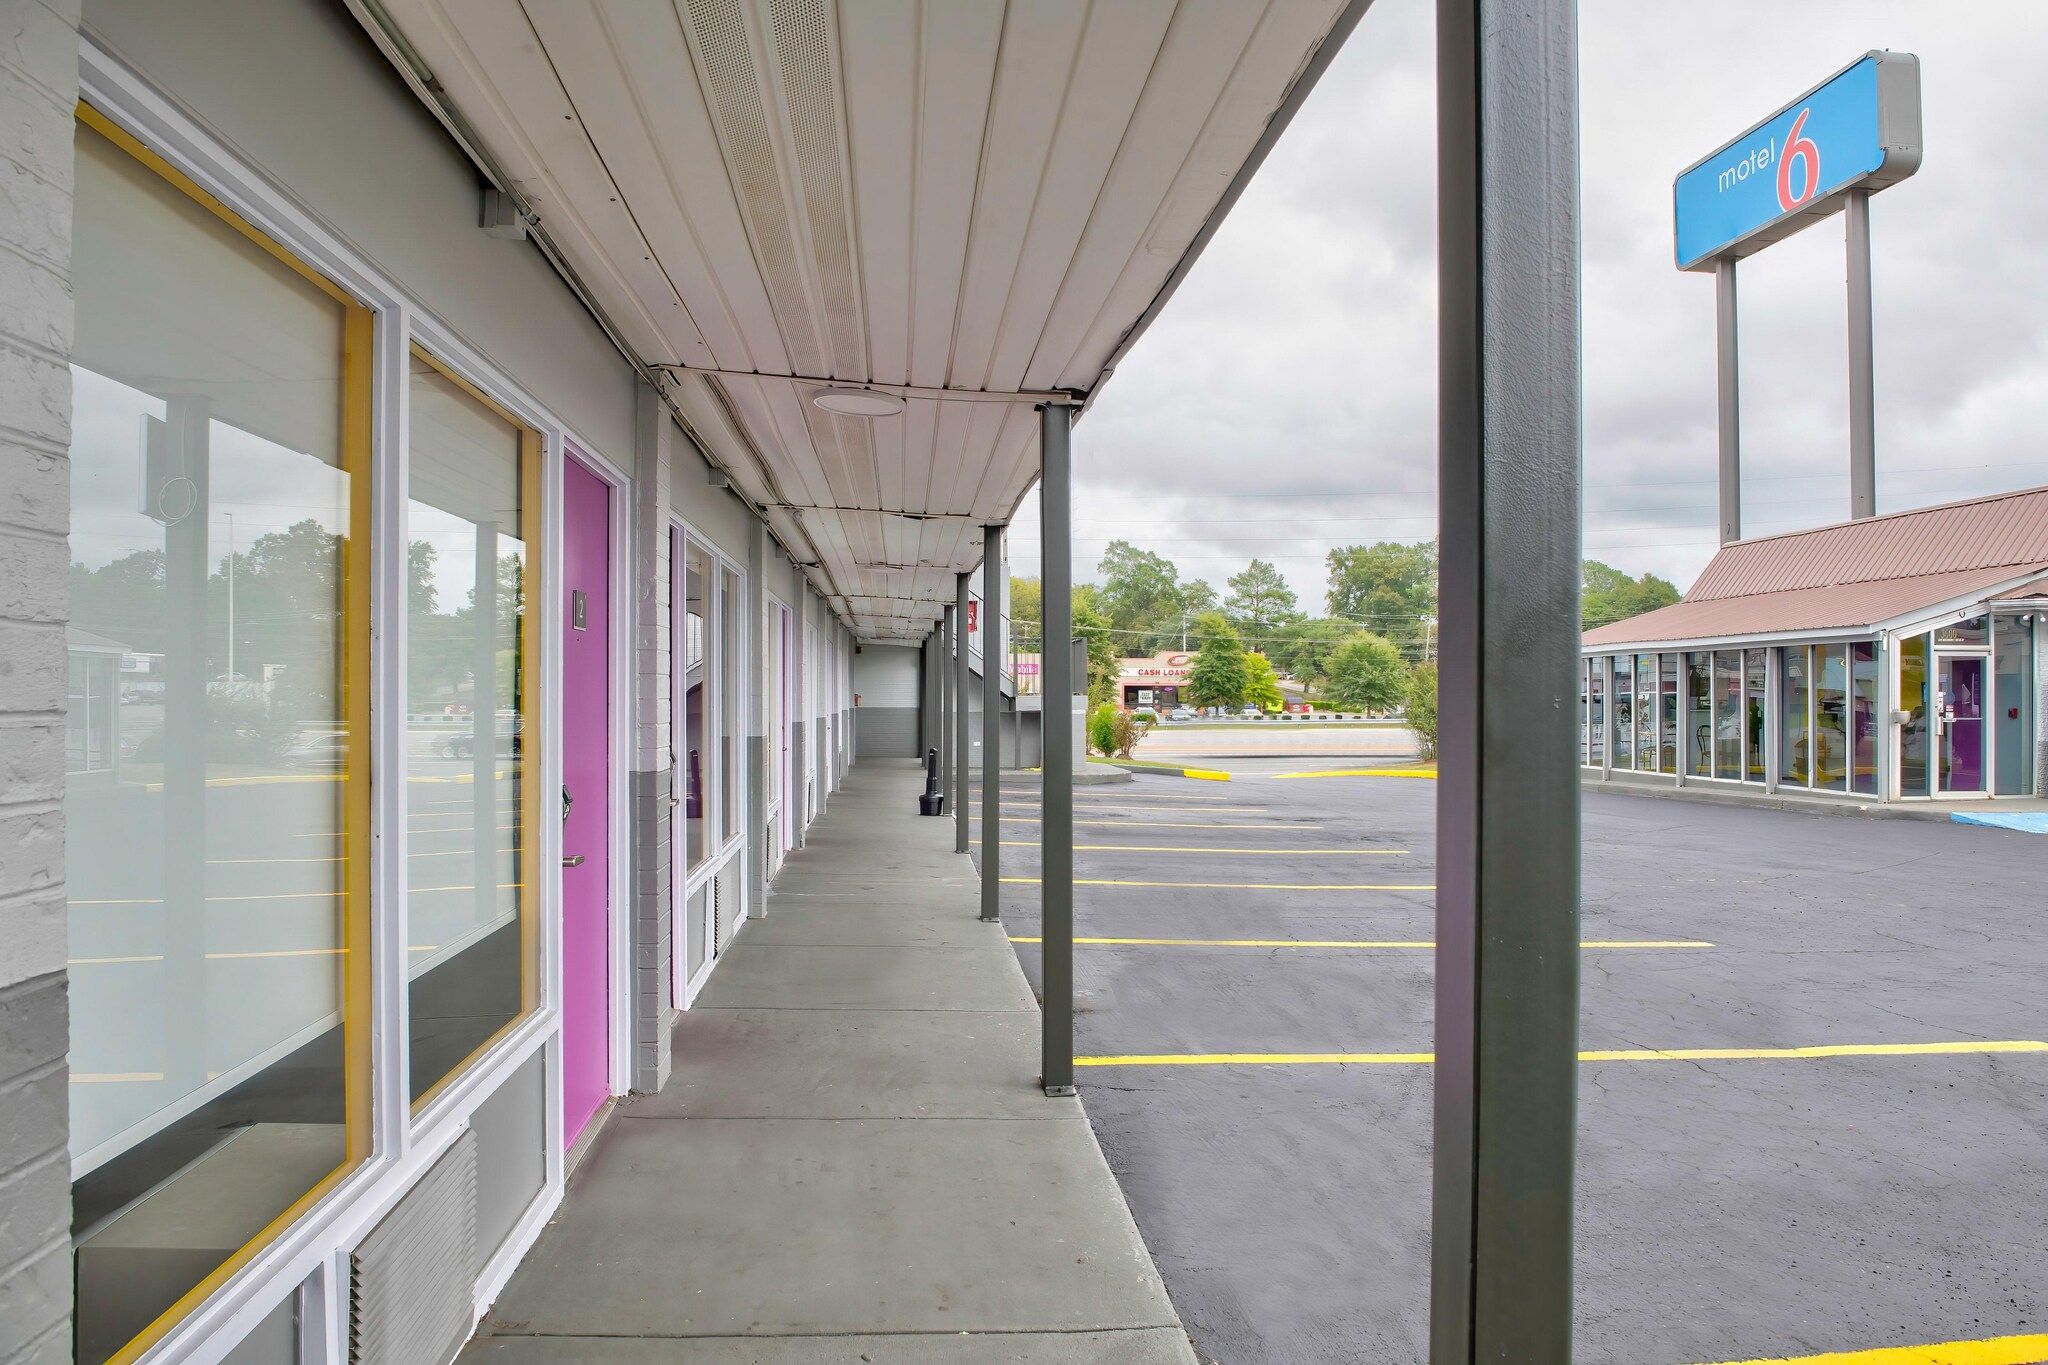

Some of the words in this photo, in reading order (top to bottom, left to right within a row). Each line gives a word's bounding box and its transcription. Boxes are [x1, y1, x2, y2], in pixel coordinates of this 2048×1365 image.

[1718, 137, 1775, 192] motel
[1776, 107, 1820, 213] 6
[1138, 668, 1160, 676] CASH
